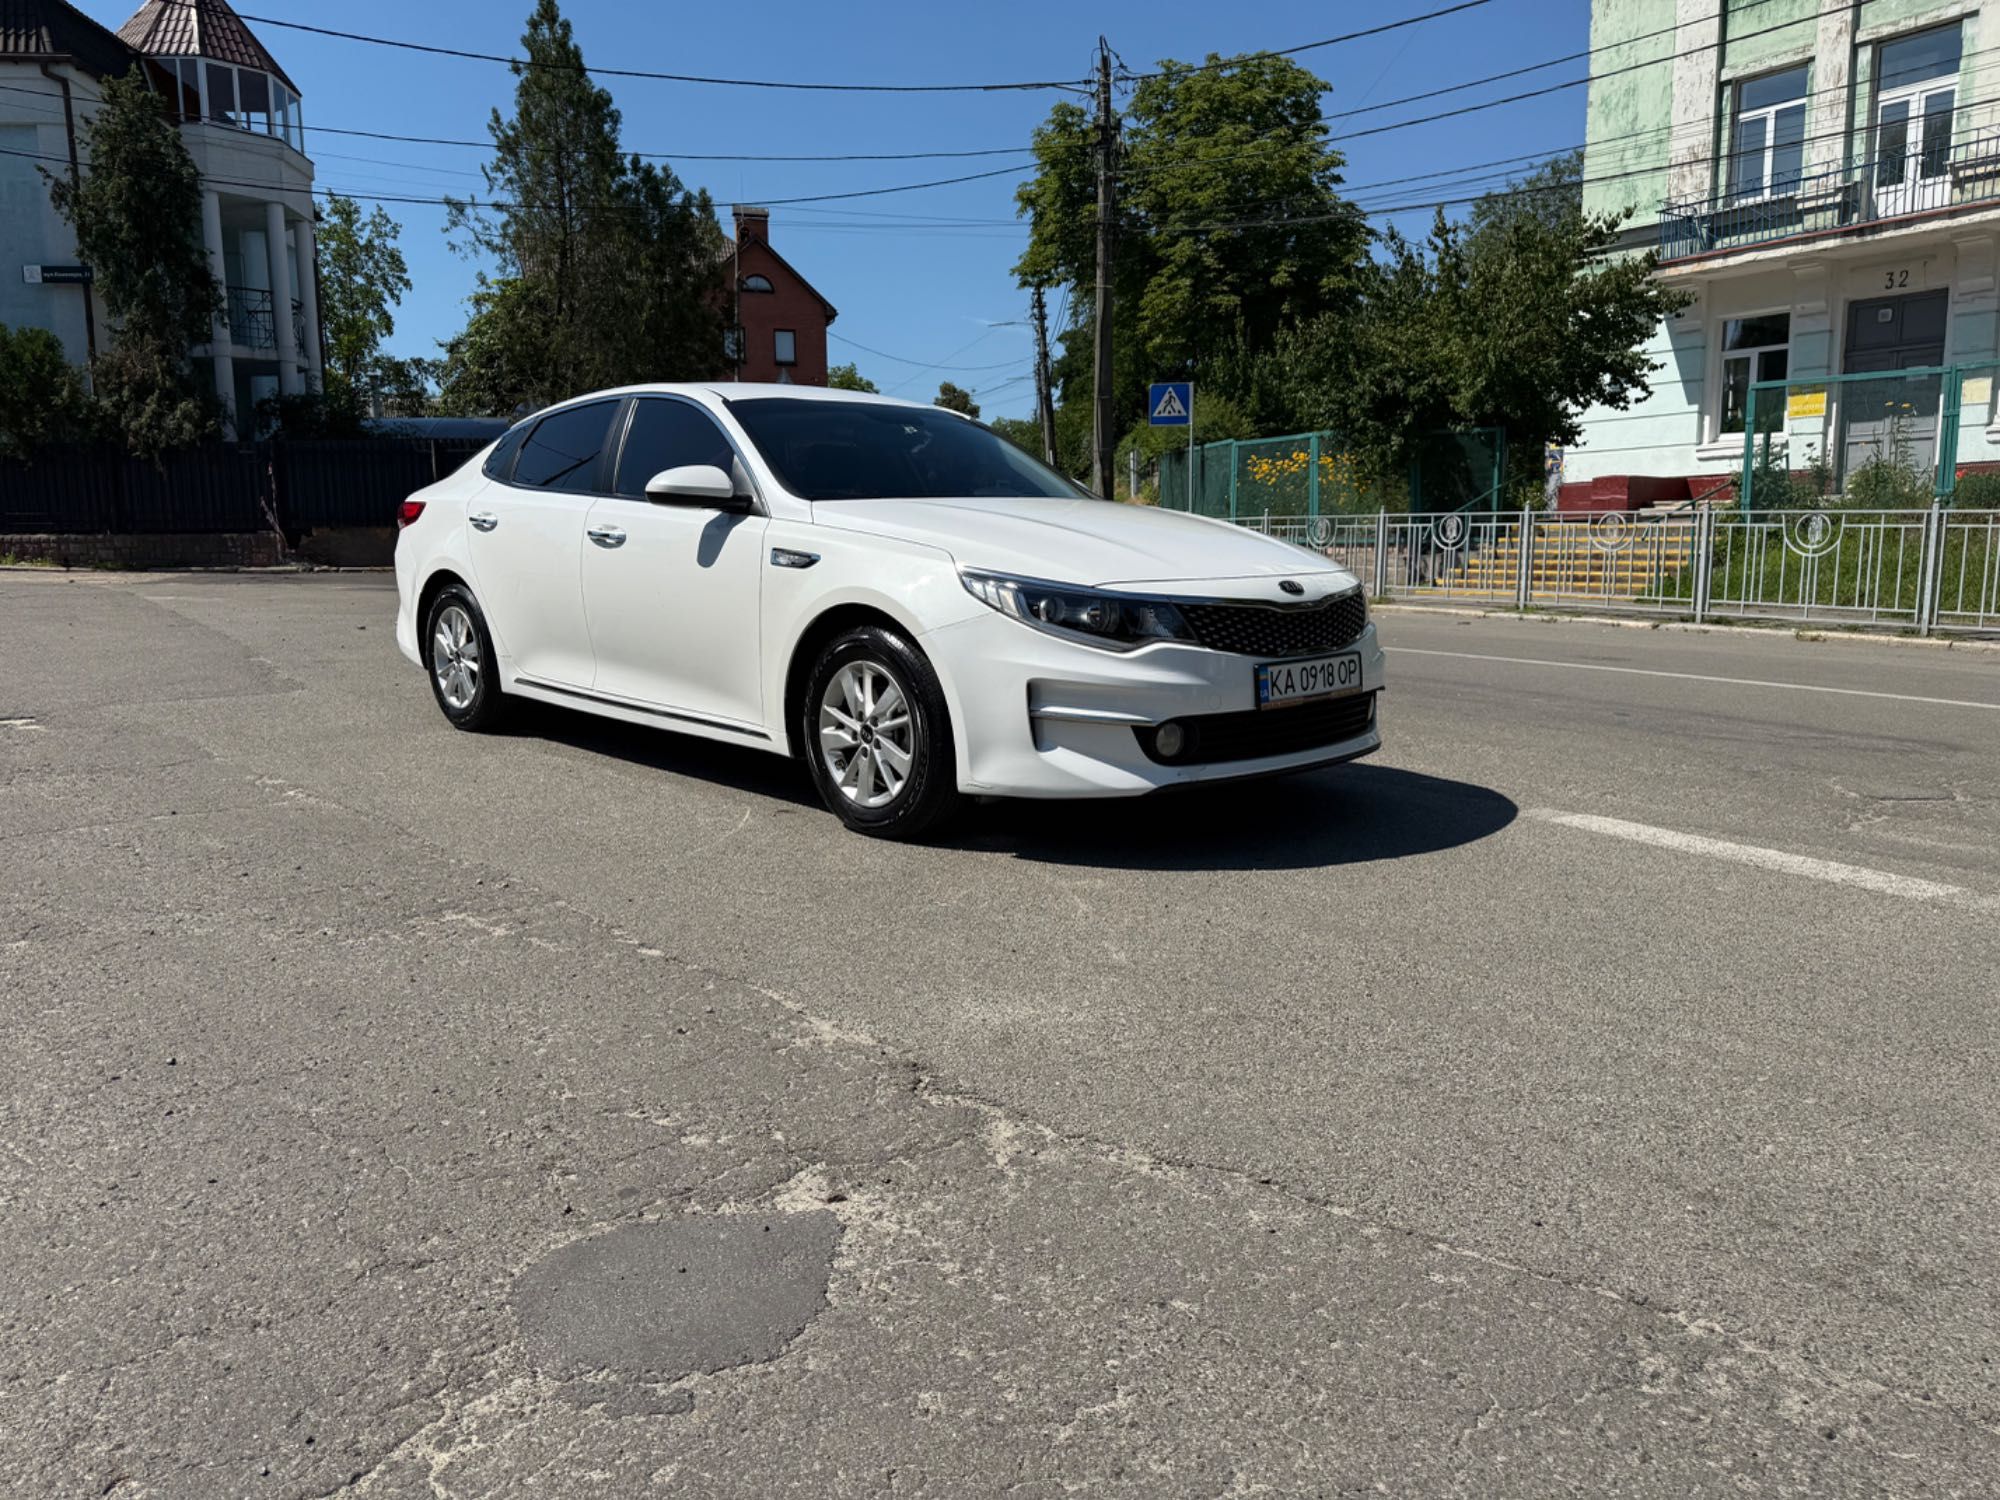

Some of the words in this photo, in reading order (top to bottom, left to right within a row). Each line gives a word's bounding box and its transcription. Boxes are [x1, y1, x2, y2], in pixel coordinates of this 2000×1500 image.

[1885, 270, 1909, 290] 32
[1270, 669, 1296, 697] KA
[1300, 663, 1335, 691] 0918
[1337, 660, 1357, 685] OP
